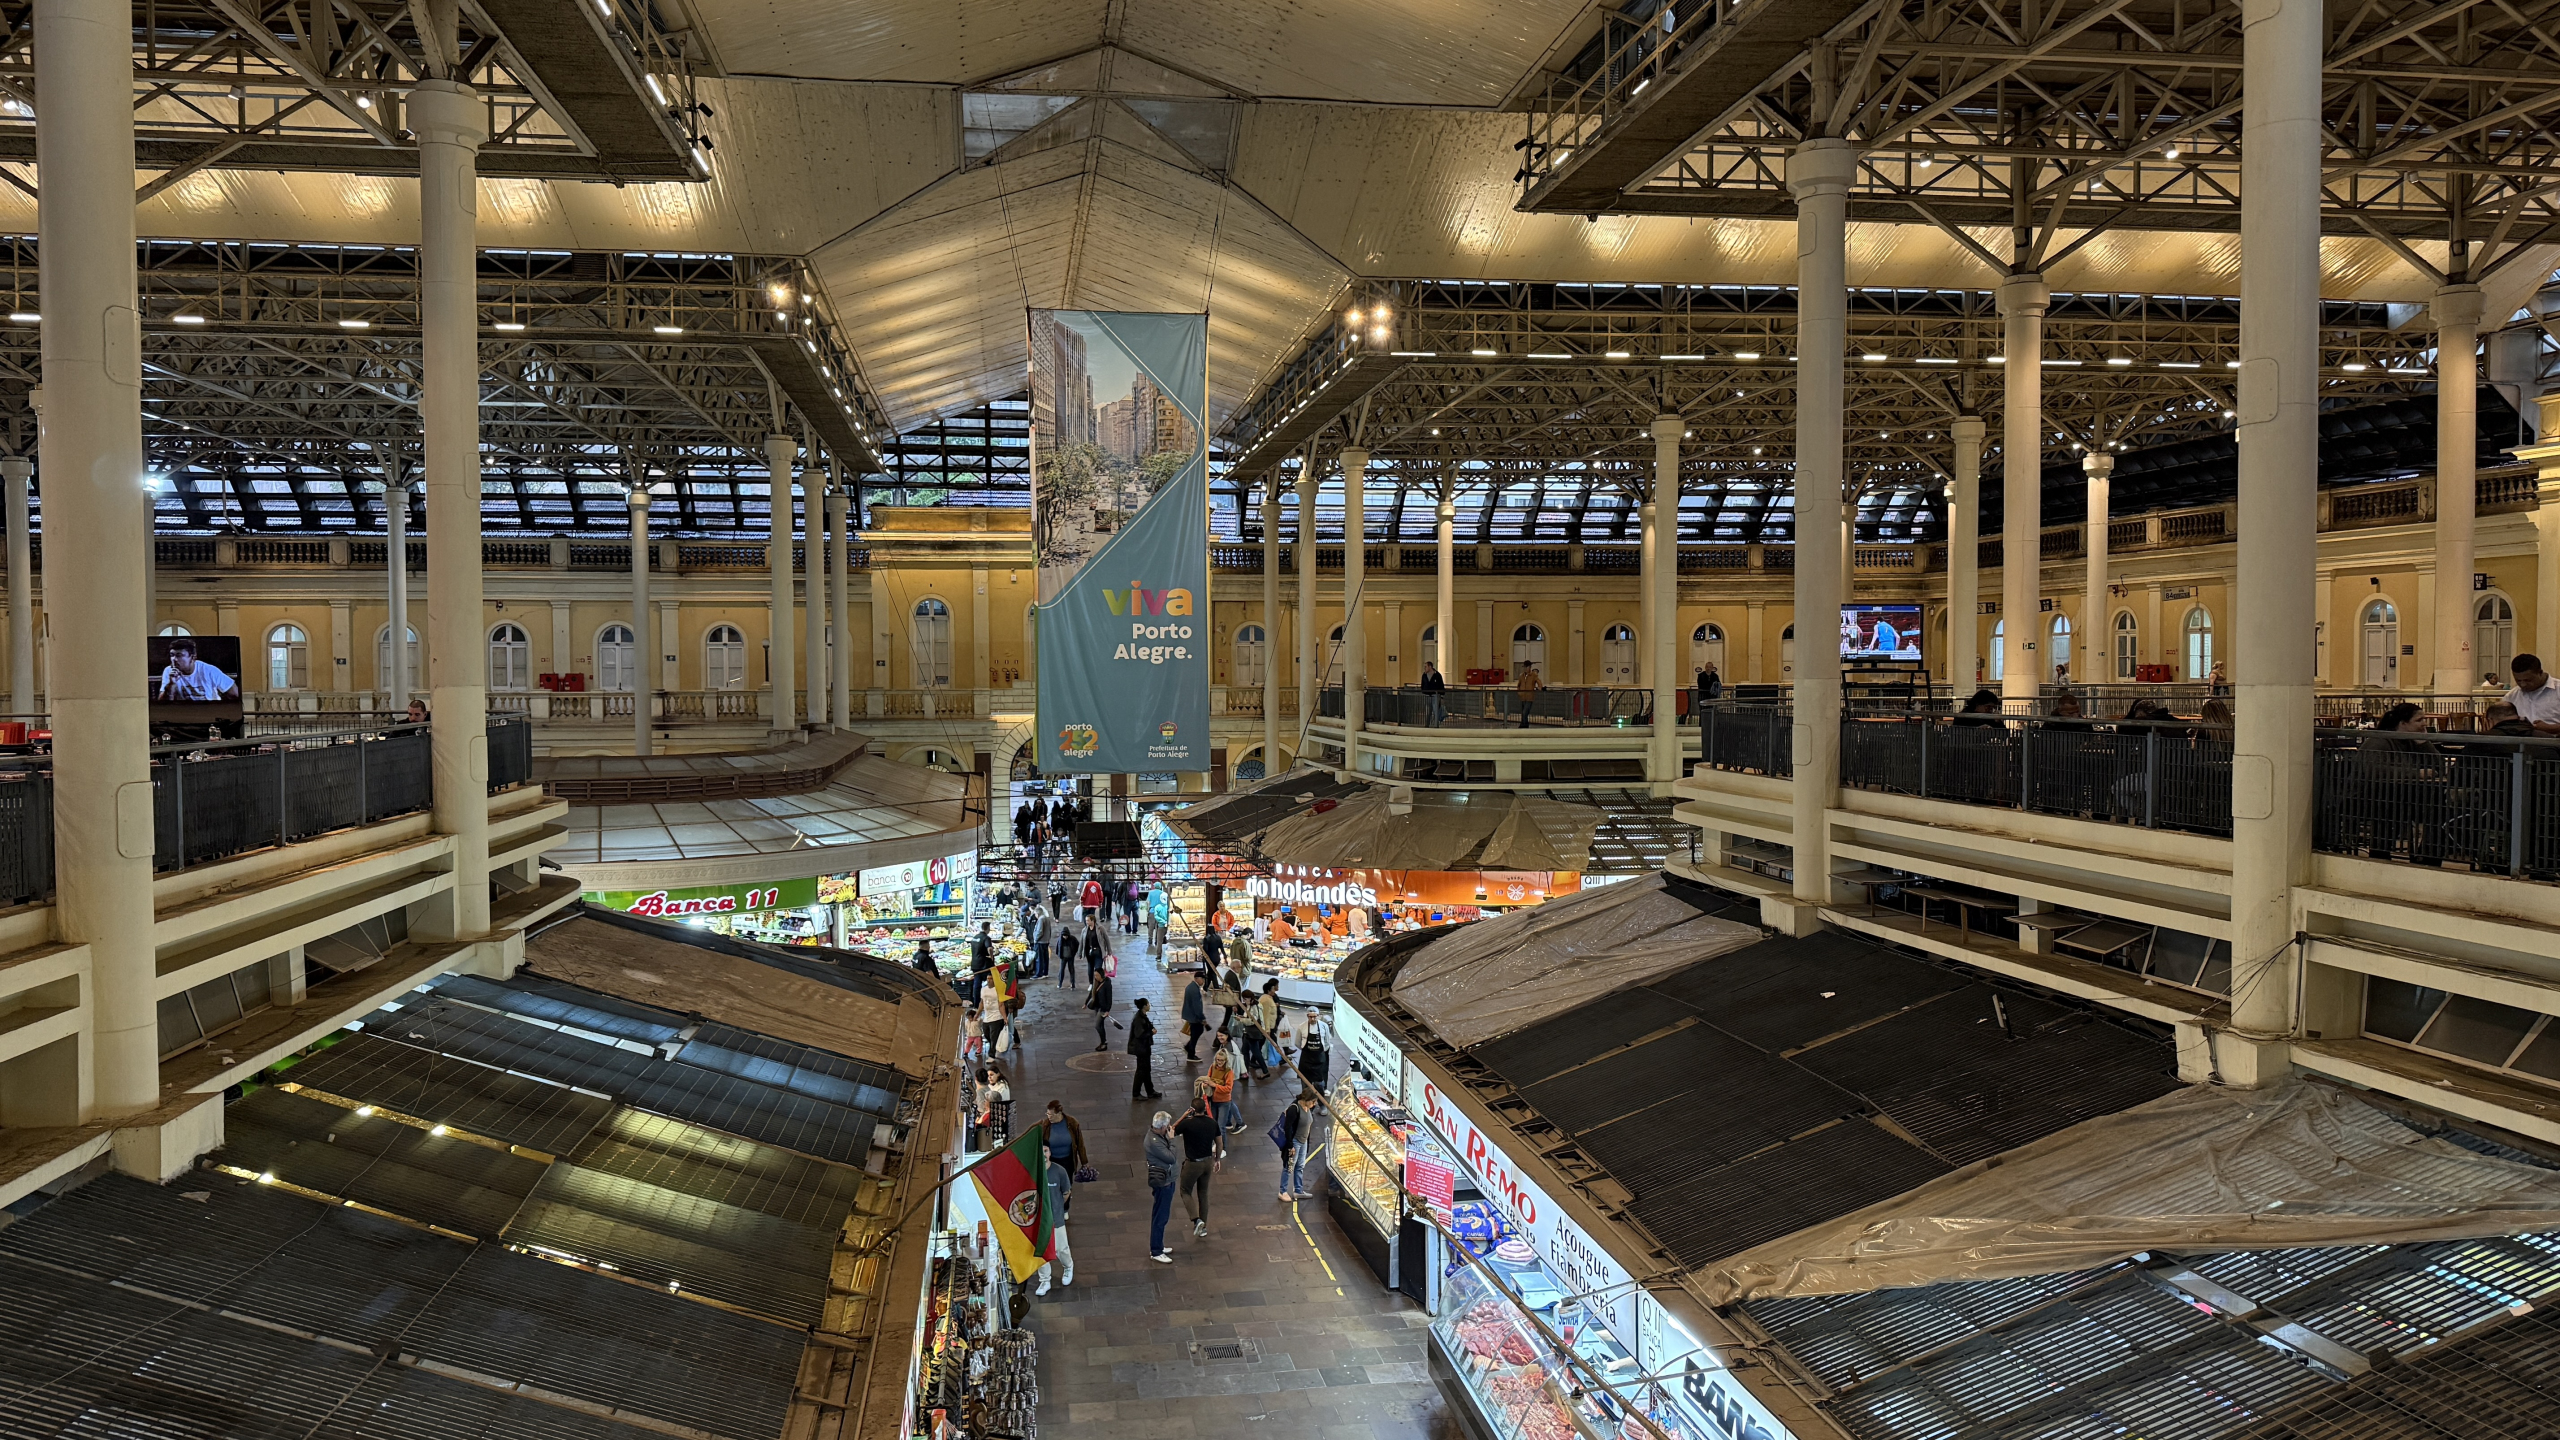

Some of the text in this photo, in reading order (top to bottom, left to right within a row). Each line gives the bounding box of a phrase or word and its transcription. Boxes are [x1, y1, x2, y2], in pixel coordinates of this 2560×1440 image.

[1102, 580, 1193, 616] viva
[1132, 623, 1193, 639] Porto
[1113, 643, 1193, 665] Alegre.
[1065, 722, 1093, 732] porto
[1059, 730, 1099, 750] 252
[1063, 748, 1094, 759] alegre
[1167, 751, 1190, 759] Alegre
[868, 873, 896, 887] banca
[931, 861, 946, 881] 10
[1275, 863, 1334, 878] BANCA
[627, 887, 779, 917] Banca 11
[1246, 875, 1378, 907] do holandês
[1422, 1083, 1458, 1145] SAN
[1466, 1126, 1537, 1225] REMO
[1477, 1172, 1536, 1244] banca 18 e 19
[1555, 1215, 1610, 1285] Açougue
[1550, 1238, 1618, 1328] Fiambreria
[1642, 1297, 1652, 1327] Q
[1642, 1323, 1663, 1352] BANCA
